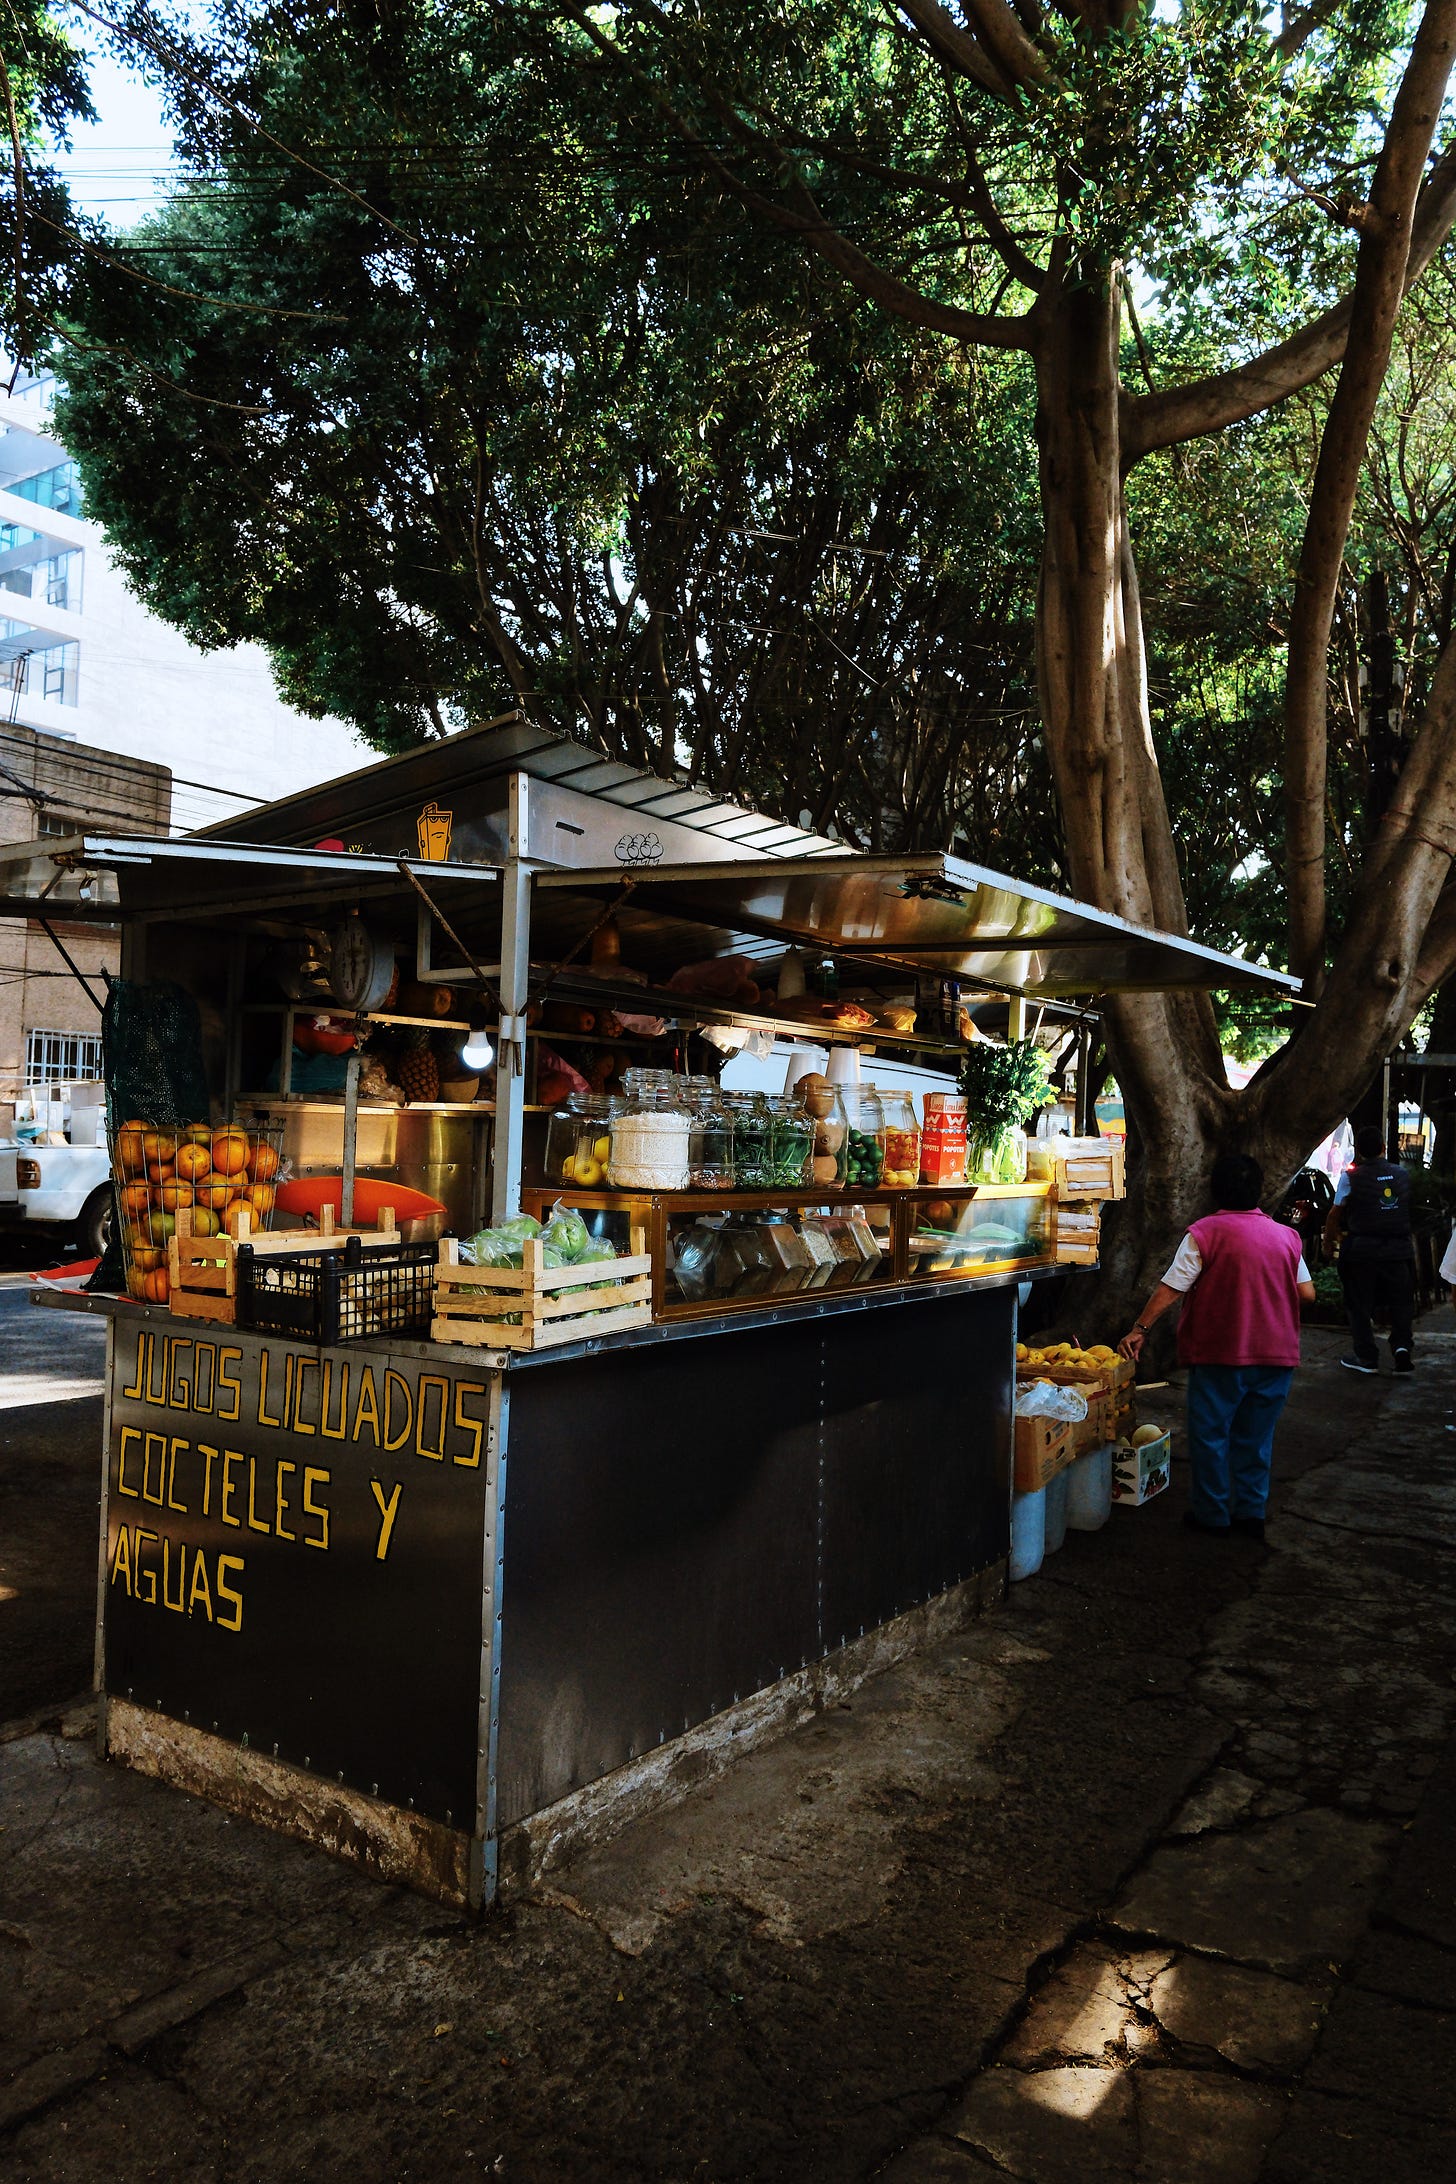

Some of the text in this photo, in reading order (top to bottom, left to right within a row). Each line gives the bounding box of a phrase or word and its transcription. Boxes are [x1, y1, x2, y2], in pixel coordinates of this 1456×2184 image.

[943, 1145, 965, 1153] POPOTES
[123, 1331, 490, 1469] JUGOS LICUADOS
[117, 1425, 405, 1562] COCTELES Y
[111, 1523, 247, 1633] AGUAS
